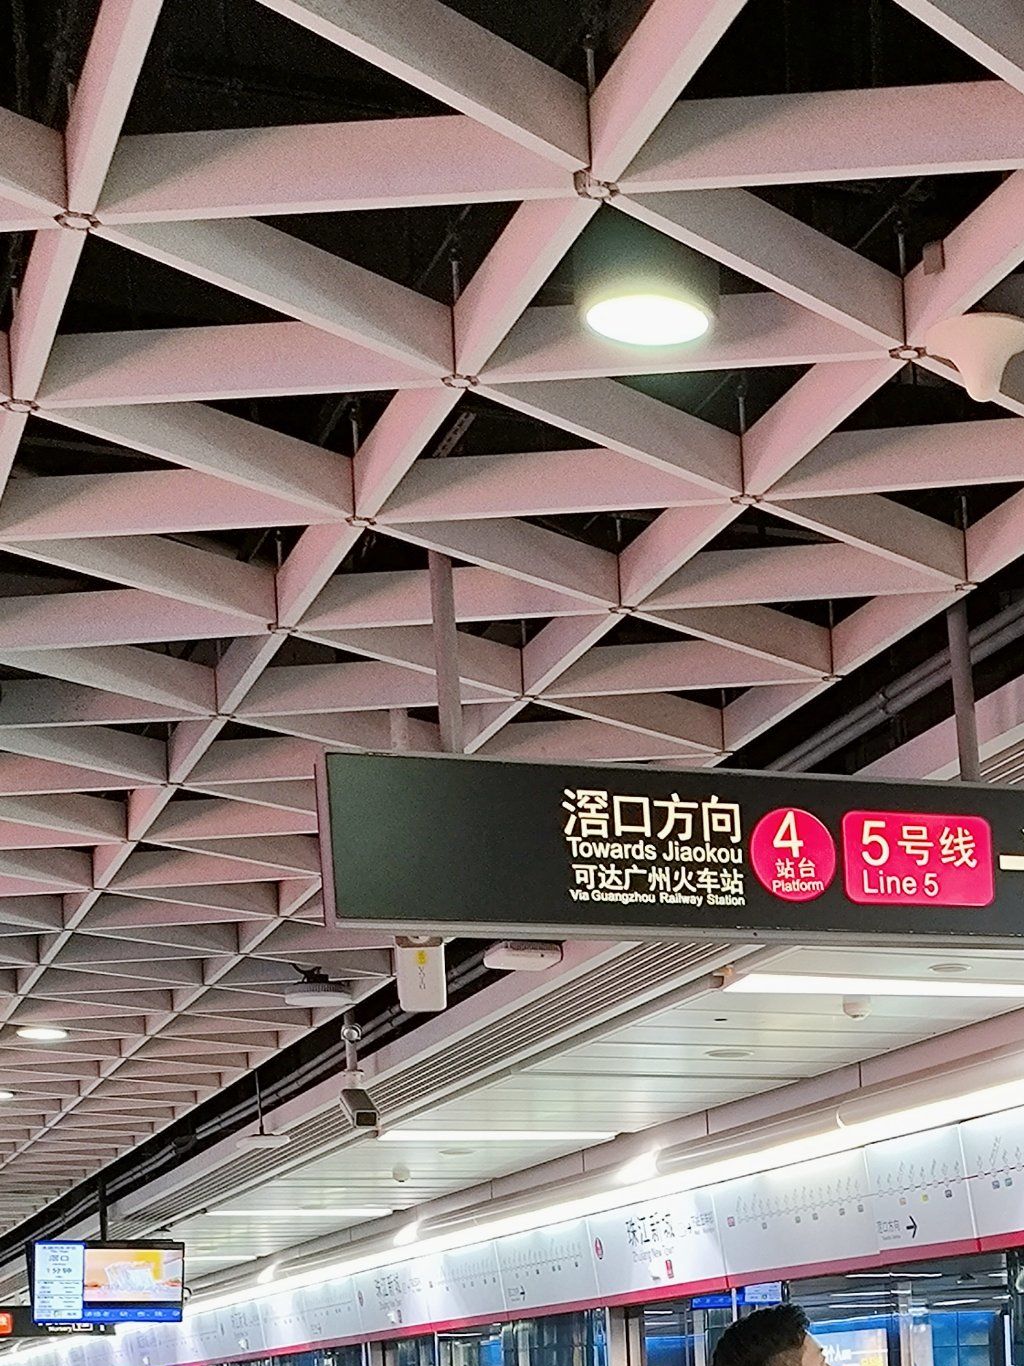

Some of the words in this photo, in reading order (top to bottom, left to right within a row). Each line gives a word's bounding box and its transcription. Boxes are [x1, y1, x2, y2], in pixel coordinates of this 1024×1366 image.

[562, 788, 741, 843] 滘口方向
[773, 810, 804, 858] 4
[861, 820, 977, 868] 5号线
[566, 836, 657, 861] Towards
[662, 840, 743, 864] Jiaokou
[571, 863, 744, 895] 可达广州火车站
[775, 857, 816, 878] 站台
[772, 879, 824, 893] Platform
[863, 869, 917, 895] Line
[923, 873, 939, 897] 5
[569, 889, 590, 901] Via
[592, 889, 656, 906] Guangzhou
[660, 892, 703, 907] Railway
[706, 893, 746, 907] Station
